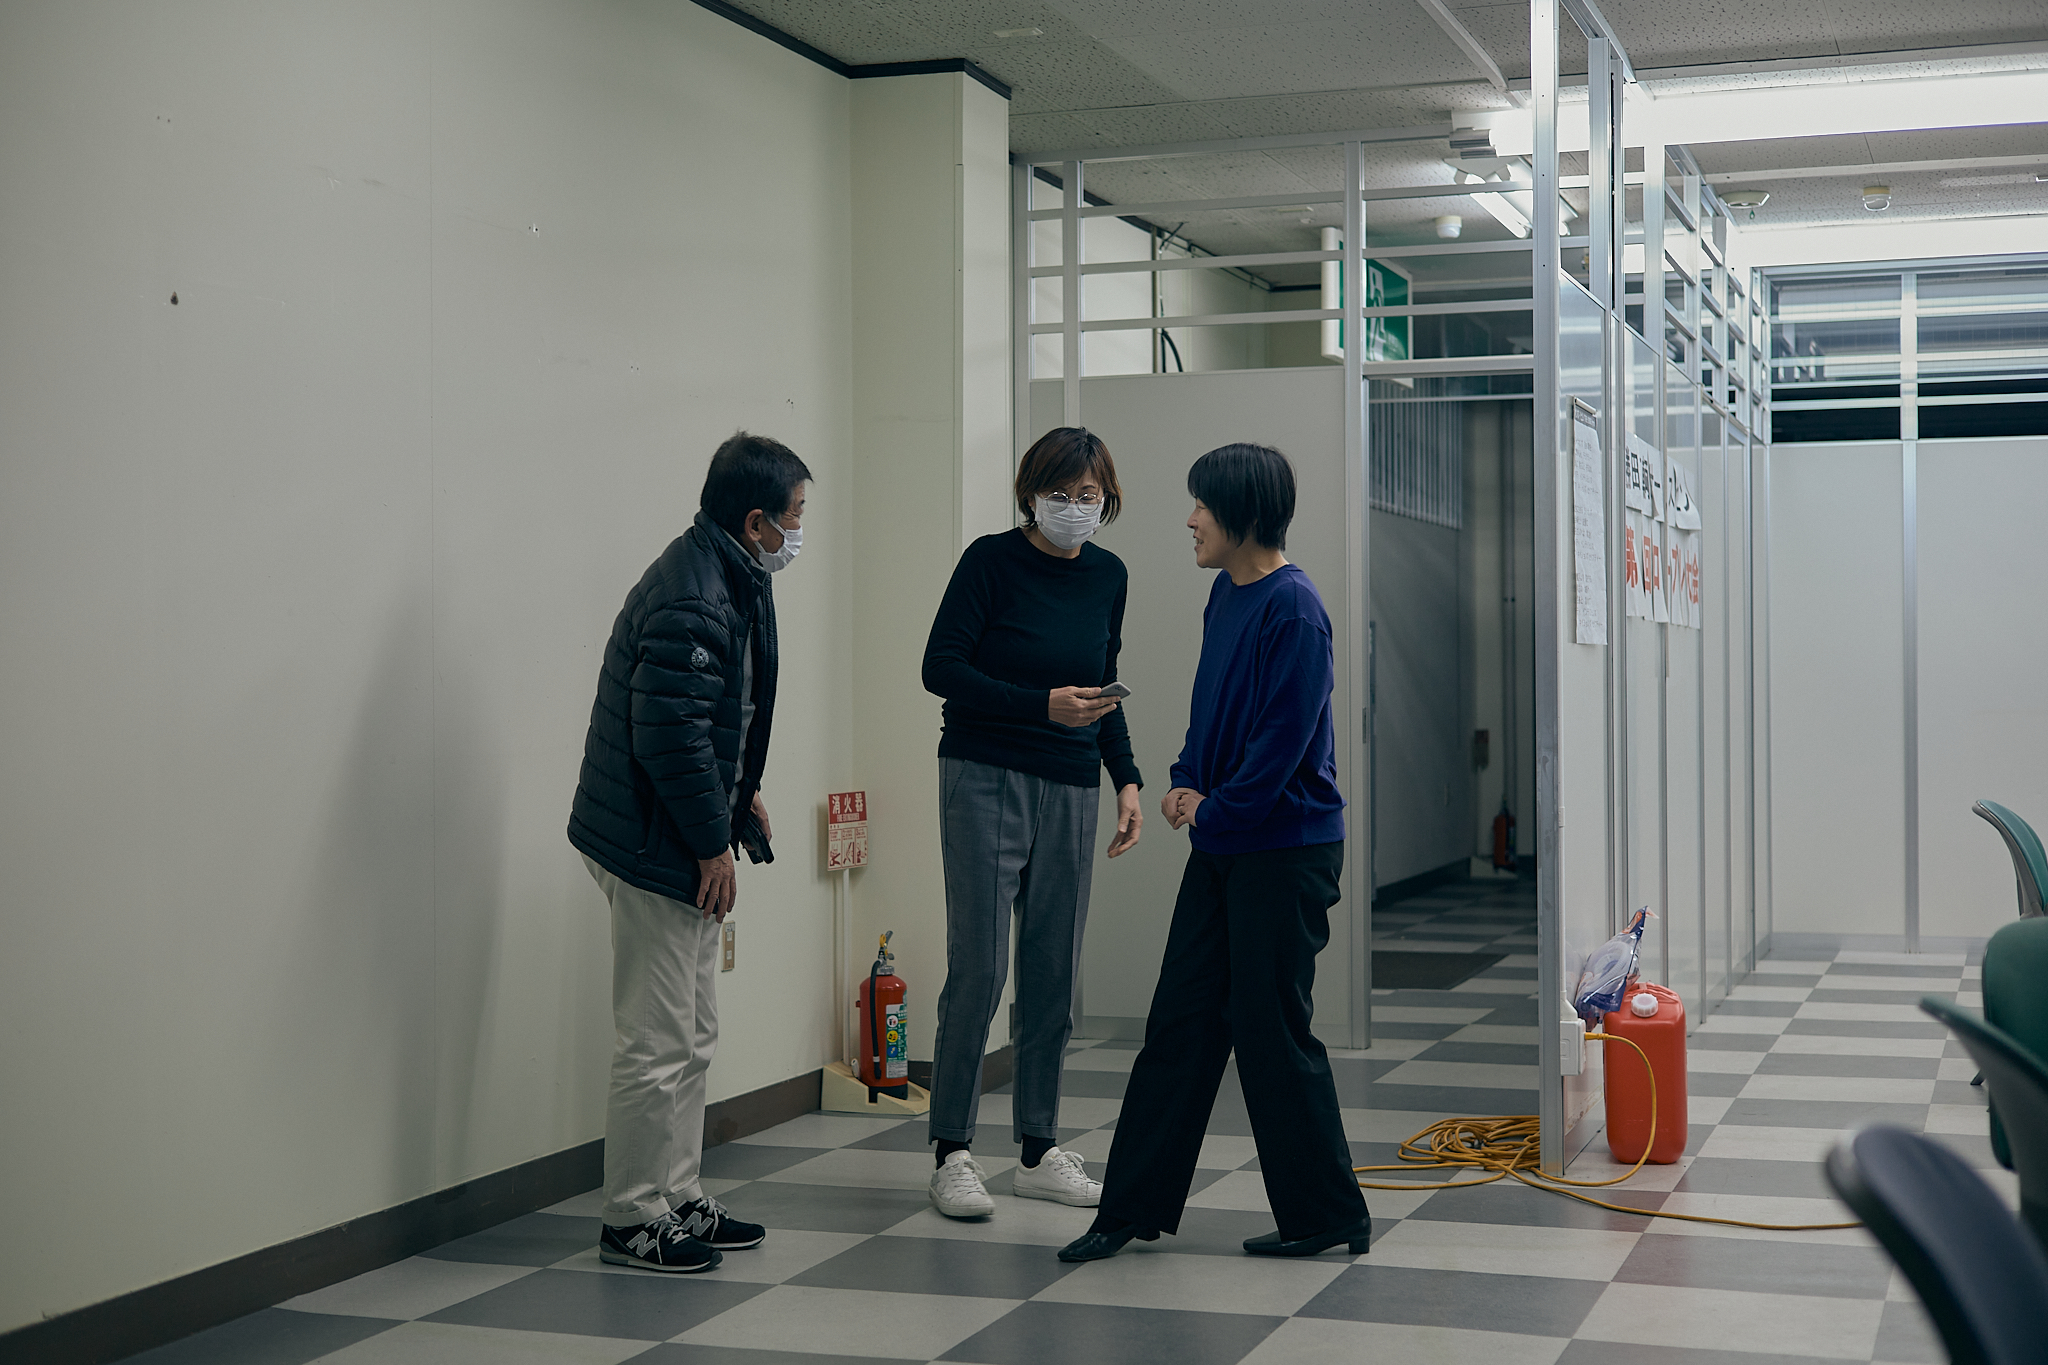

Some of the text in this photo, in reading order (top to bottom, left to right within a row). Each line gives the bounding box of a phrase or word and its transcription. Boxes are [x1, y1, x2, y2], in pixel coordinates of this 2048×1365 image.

[831, 792, 864, 815] 消火器
[680, 1210, 714, 1237] N
[626, 1230, 657, 1258] N
